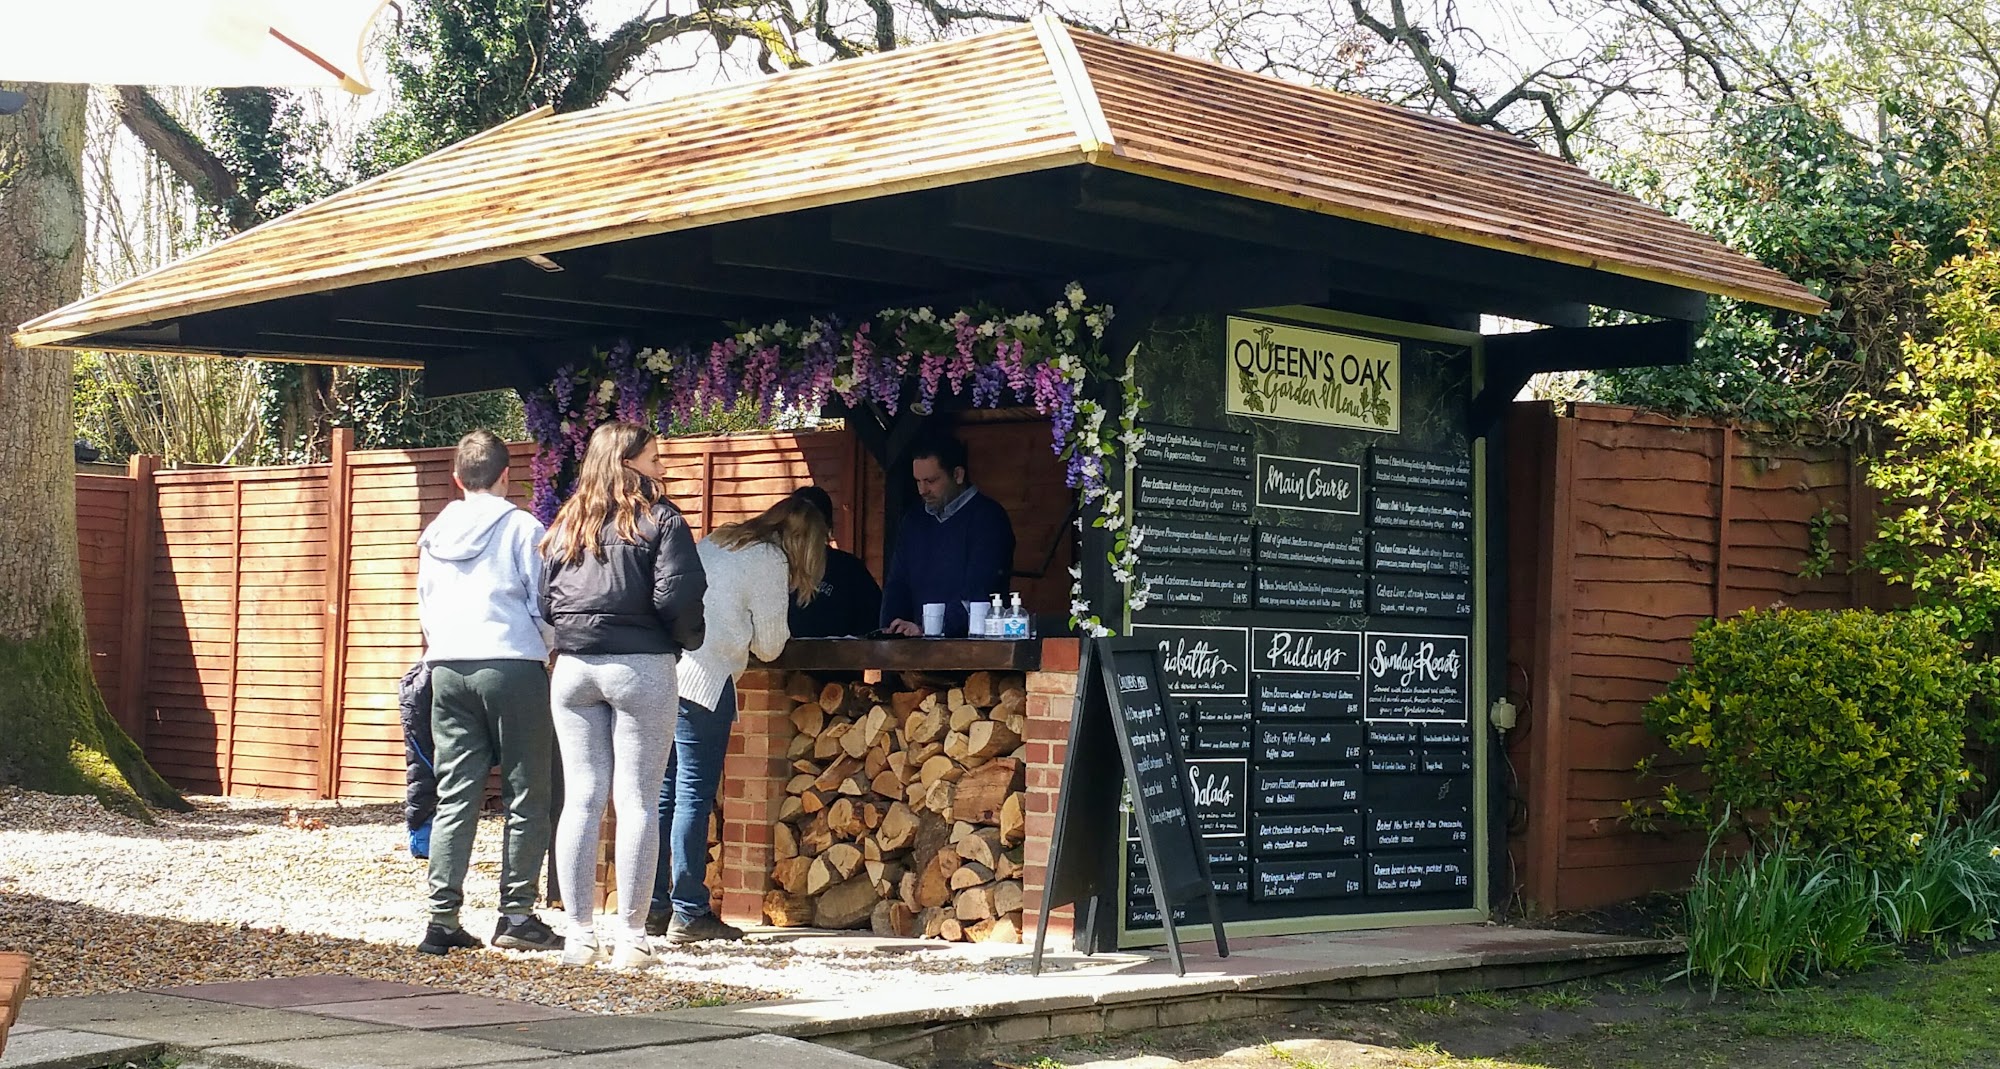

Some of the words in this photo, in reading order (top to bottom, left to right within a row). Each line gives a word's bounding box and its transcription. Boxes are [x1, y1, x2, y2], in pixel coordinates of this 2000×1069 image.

[1253, 326, 1274, 351] The
[1234, 339, 1334, 382] QUEEN'S
[1341, 354, 1391, 390] OAK
[1264, 370, 1320, 413] Garden
[1319, 378, 1362, 417] Menu
[1265, 465, 1305, 501] Main
[1306, 467, 1351, 500] Course
[1176, 497, 1187, 506] and
[1189, 497, 1208, 510] chunky
[1210, 500, 1224, 511] chips
[1267, 632, 1347, 670] Puddings
[1369, 639, 1416, 687] Sunday
[1413, 641, 1461, 681] Roasts
[1189, 765, 1233, 806] Salads
[1260, 825, 1272, 836] Dark
[1272, 825, 1293, 834] Chocolate
[1263, 842, 1273, 850] with
[1374, 864, 1390, 875] Cheese
[1265, 885, 1277, 896] fruit
[1399, 879, 1409, 888] and
